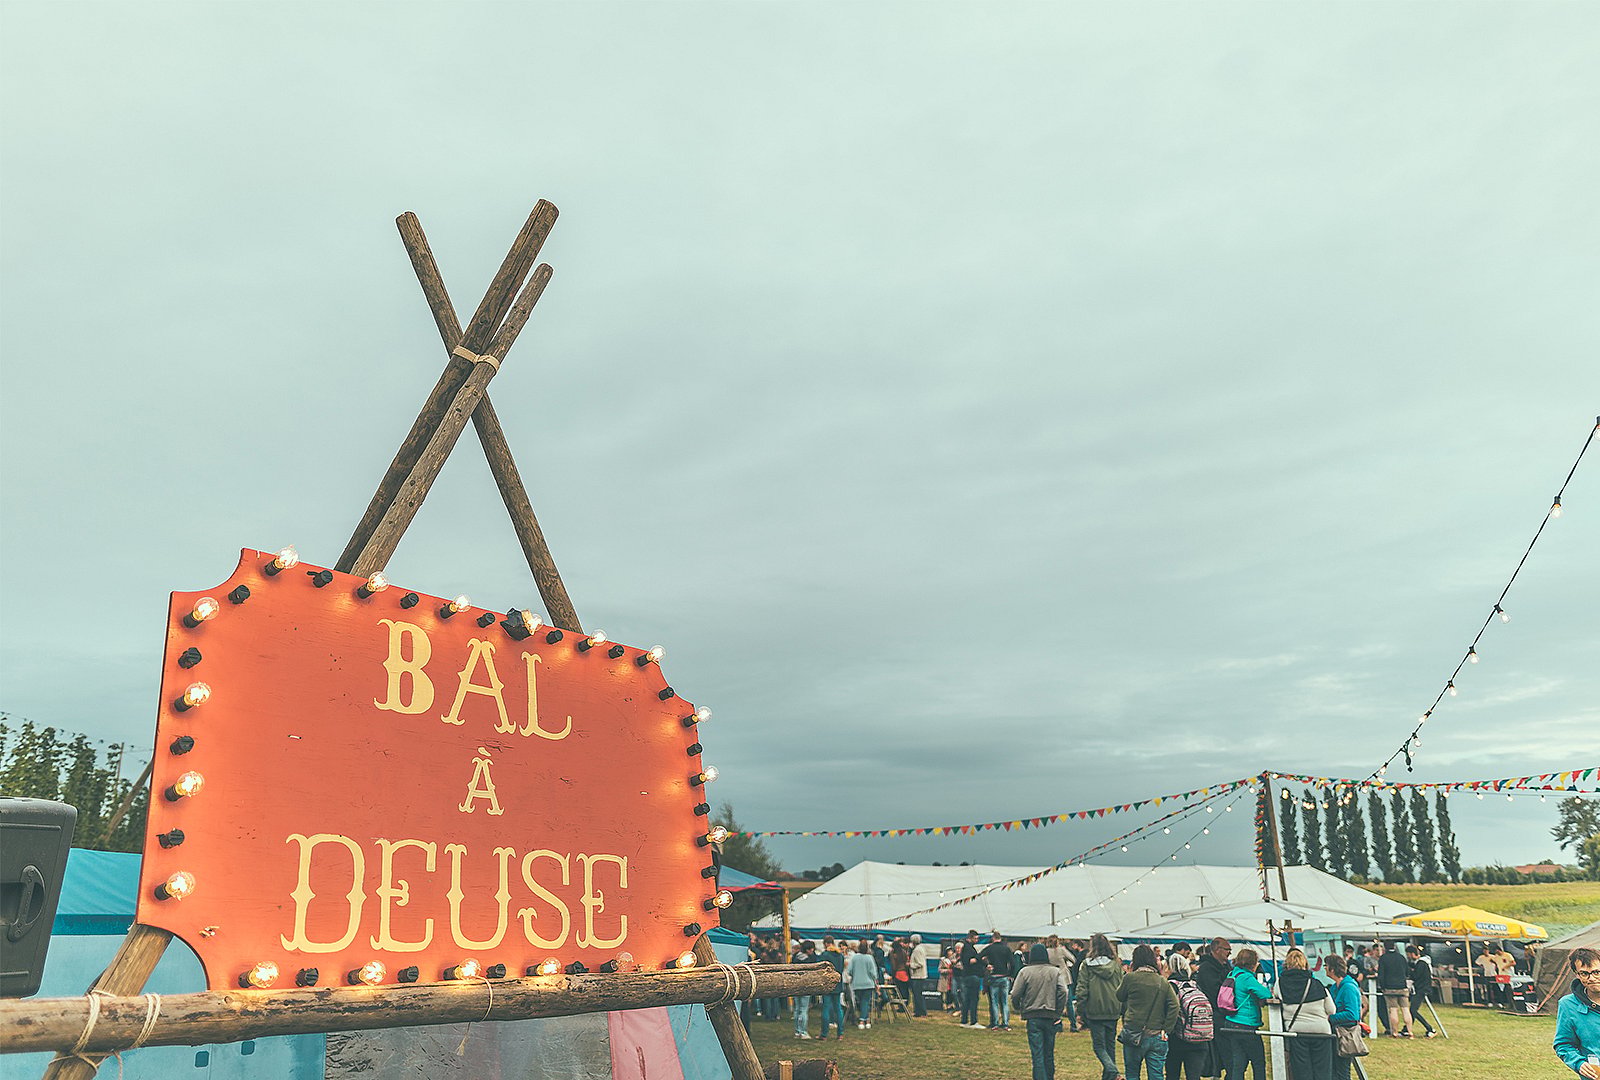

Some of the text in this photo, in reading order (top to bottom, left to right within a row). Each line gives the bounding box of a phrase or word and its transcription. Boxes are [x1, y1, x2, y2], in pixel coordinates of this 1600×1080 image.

[373, 618, 573, 740] BAL
[458, 746, 505, 816] À
[280, 833, 629, 954] DEUSE
[1422, 920, 1451, 928] RICARD
[1476, 922, 1507, 931] RICARD
